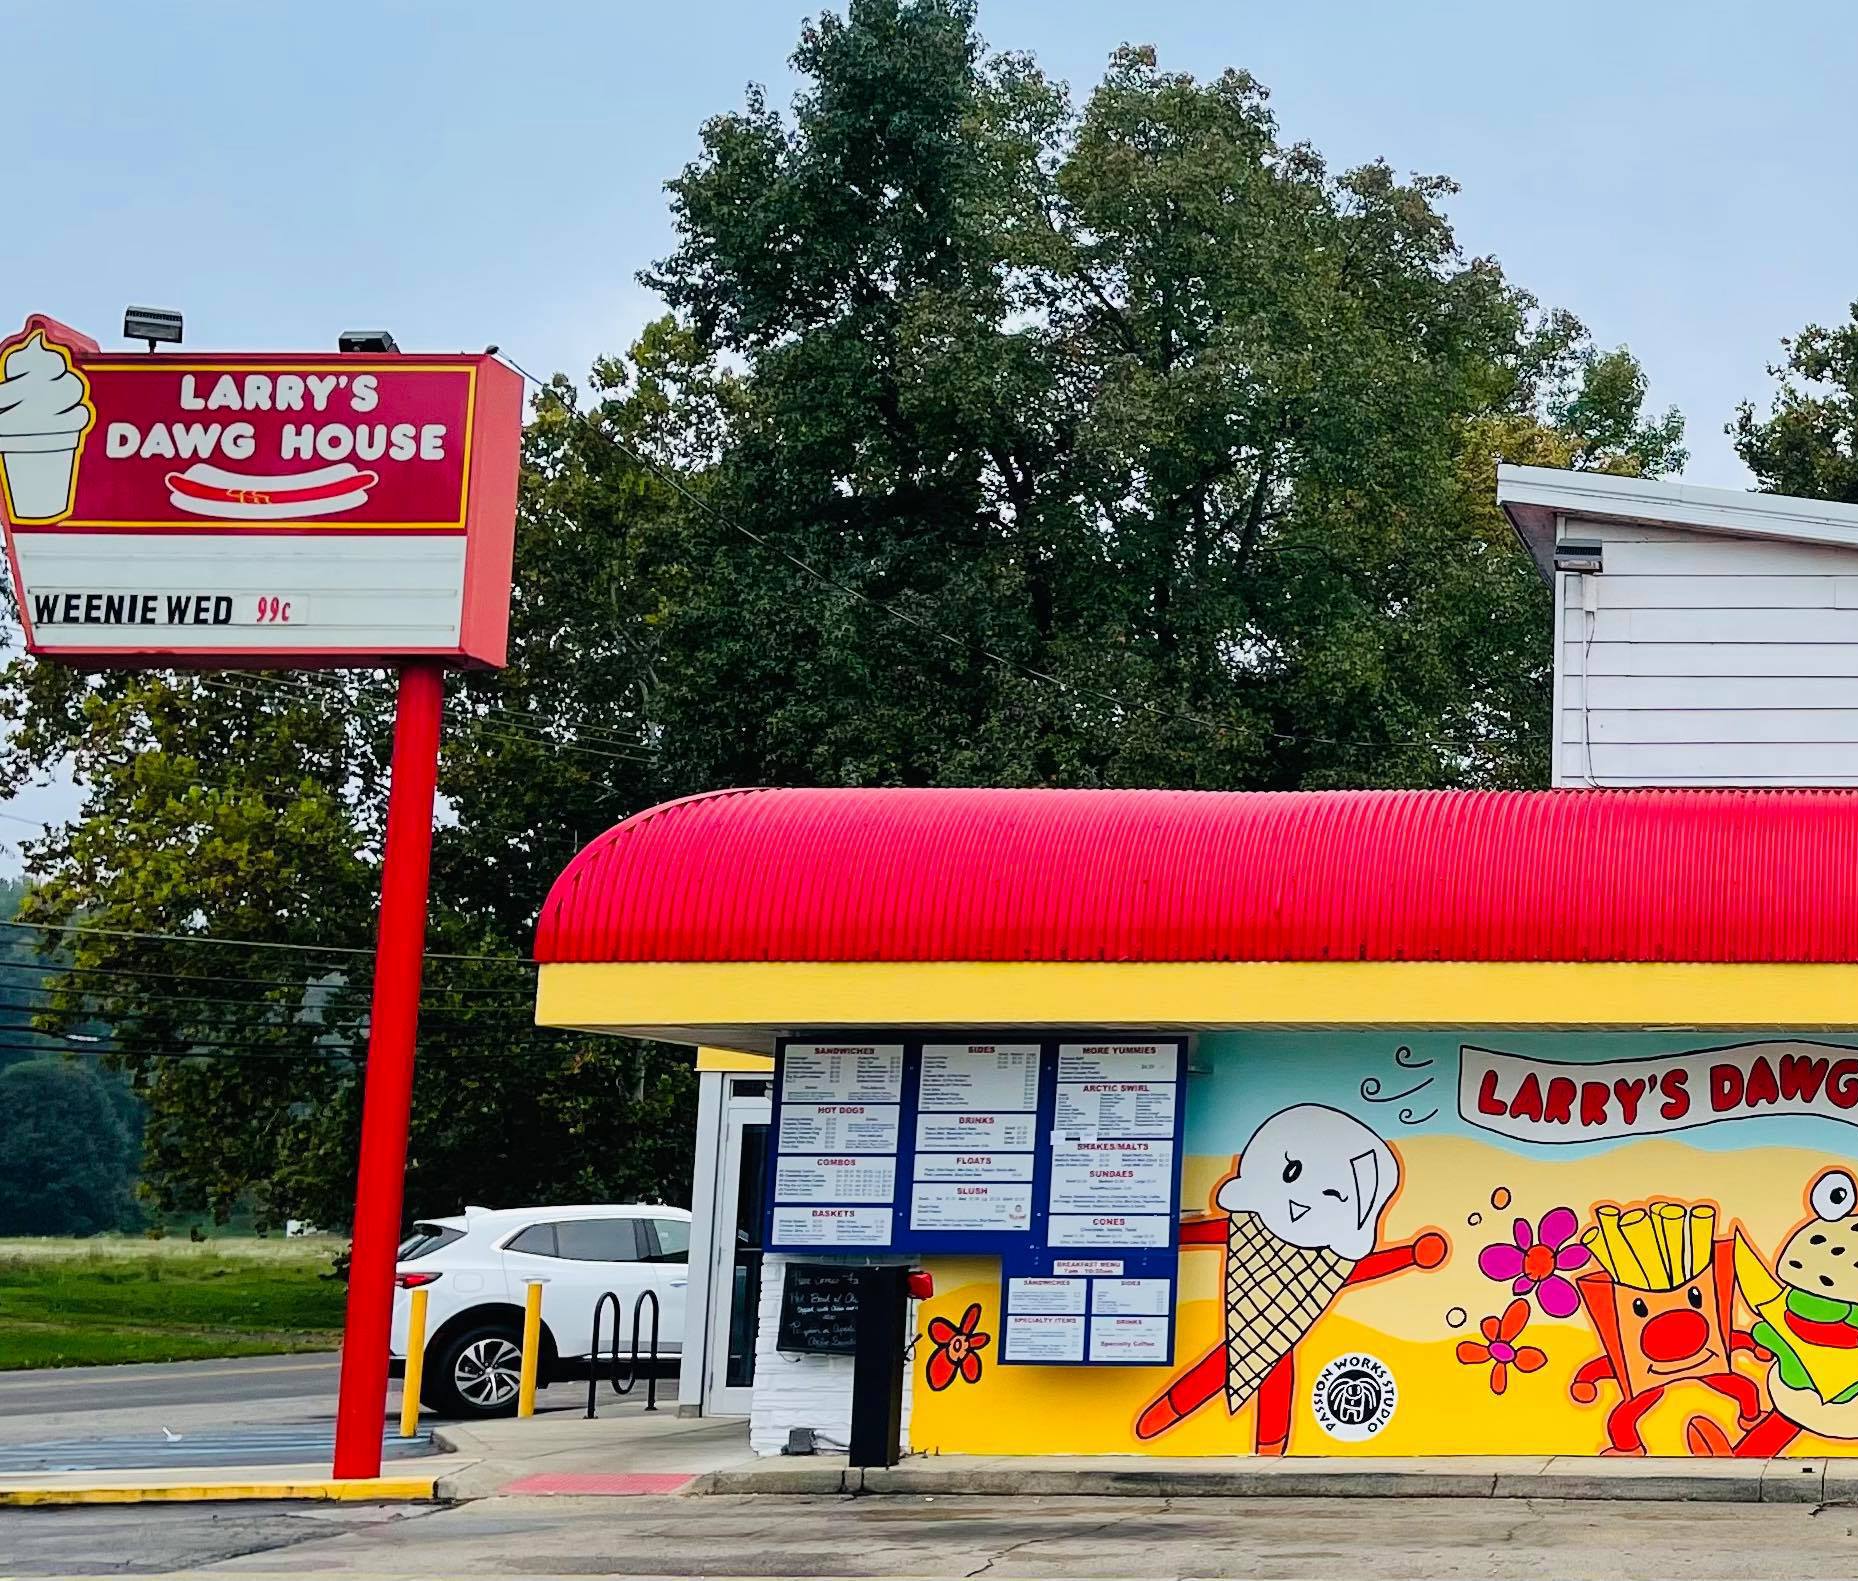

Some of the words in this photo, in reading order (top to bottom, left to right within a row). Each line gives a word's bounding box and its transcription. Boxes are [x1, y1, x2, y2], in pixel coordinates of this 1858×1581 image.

[180, 374, 379, 411] LARRY'S
[106, 423, 256, 459] DAWG
[280, 424, 448, 461] HOUSE
[34, 594, 157, 625] WEENIE
[167, 596, 233, 625] WED
[1477, 1069, 1691, 1127] LARRY'S
[1313, 1368, 1336, 1431] PASSION
[1334, 1356, 1387, 1378] WORKS
[1368, 1380, 1395, 1432] STUDIO
